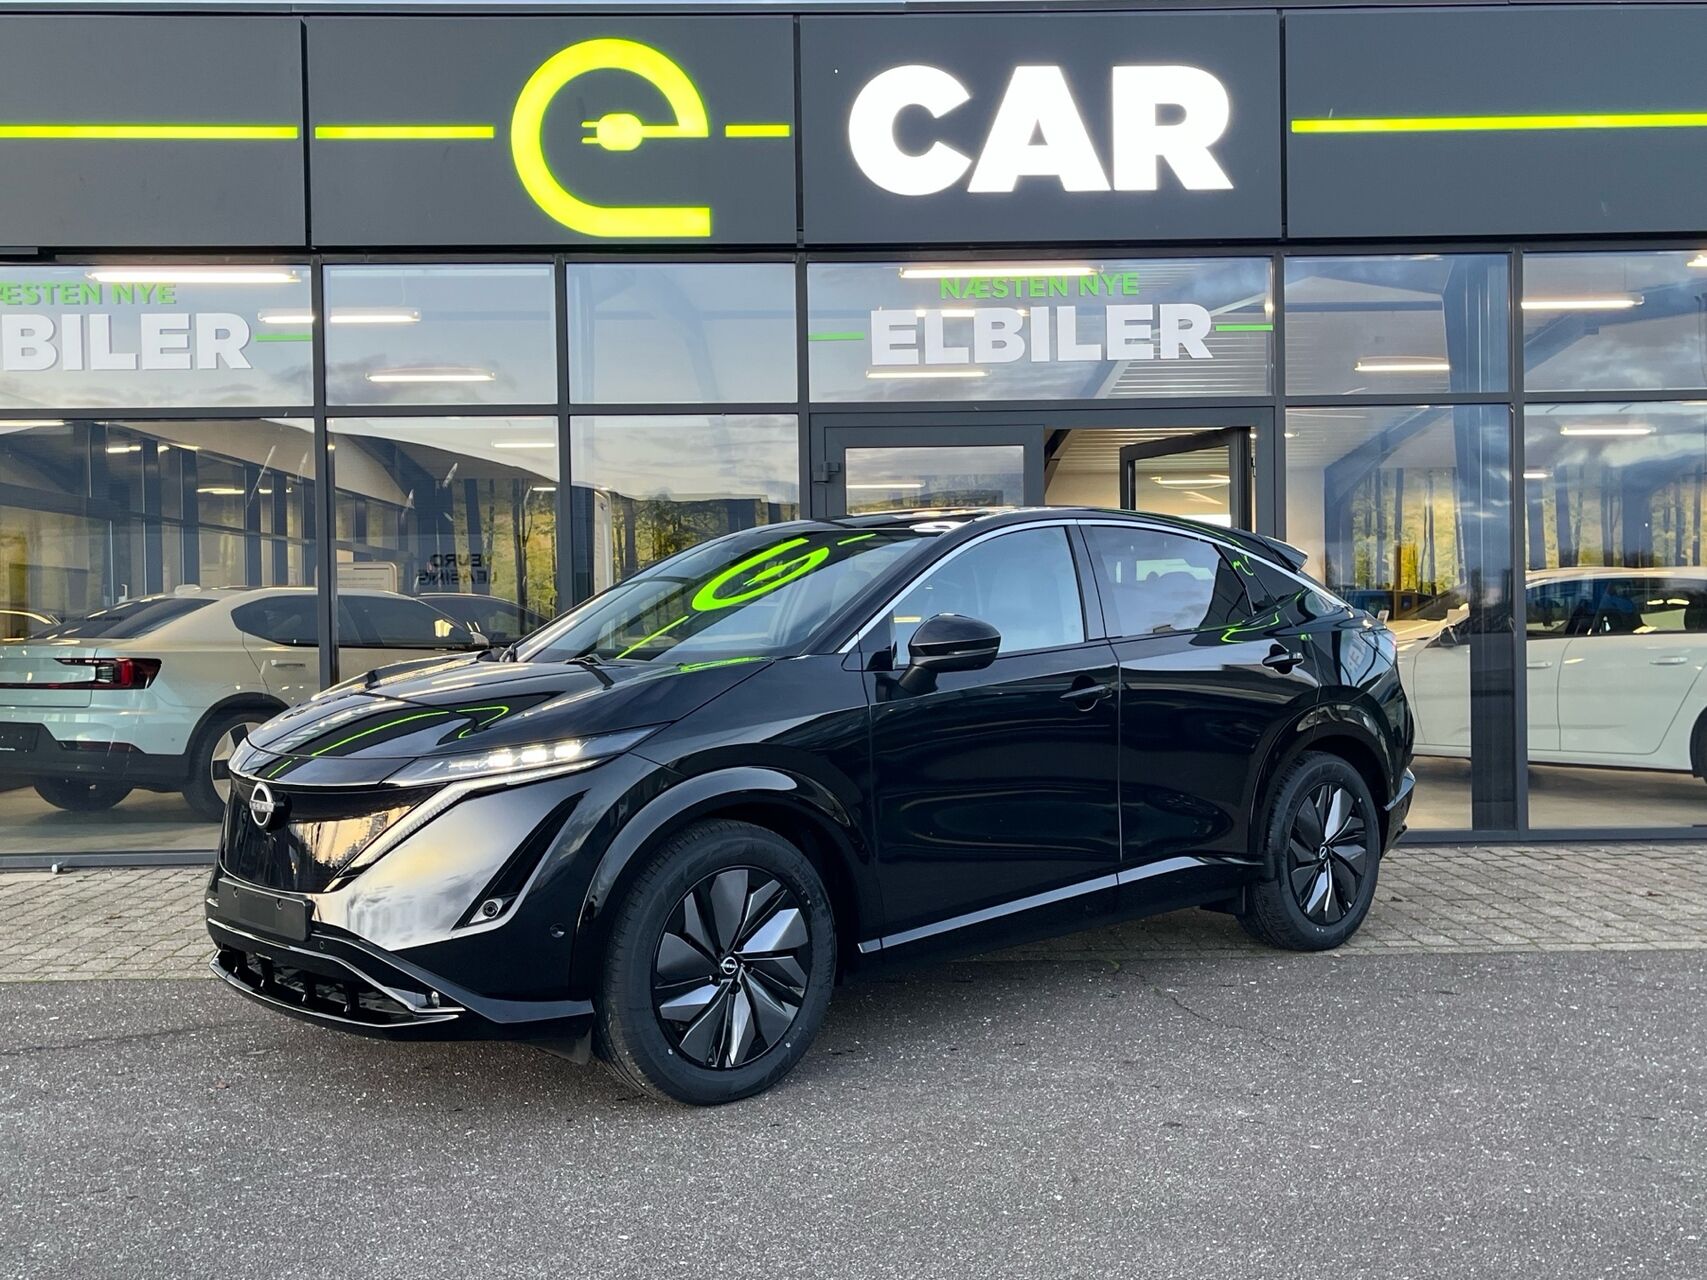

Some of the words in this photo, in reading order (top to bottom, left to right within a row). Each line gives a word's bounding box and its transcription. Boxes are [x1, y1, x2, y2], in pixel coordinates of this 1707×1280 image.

[849, 64, 1234, 196] CAR
[111, 282, 177, 305] NYE
[940, 274, 1068, 299] NÆSTEN
[1078, 272, 1140, 297] NYE
[1, 313, 253, 371] BILER
[871, 303, 1214, 366] ELBILER
